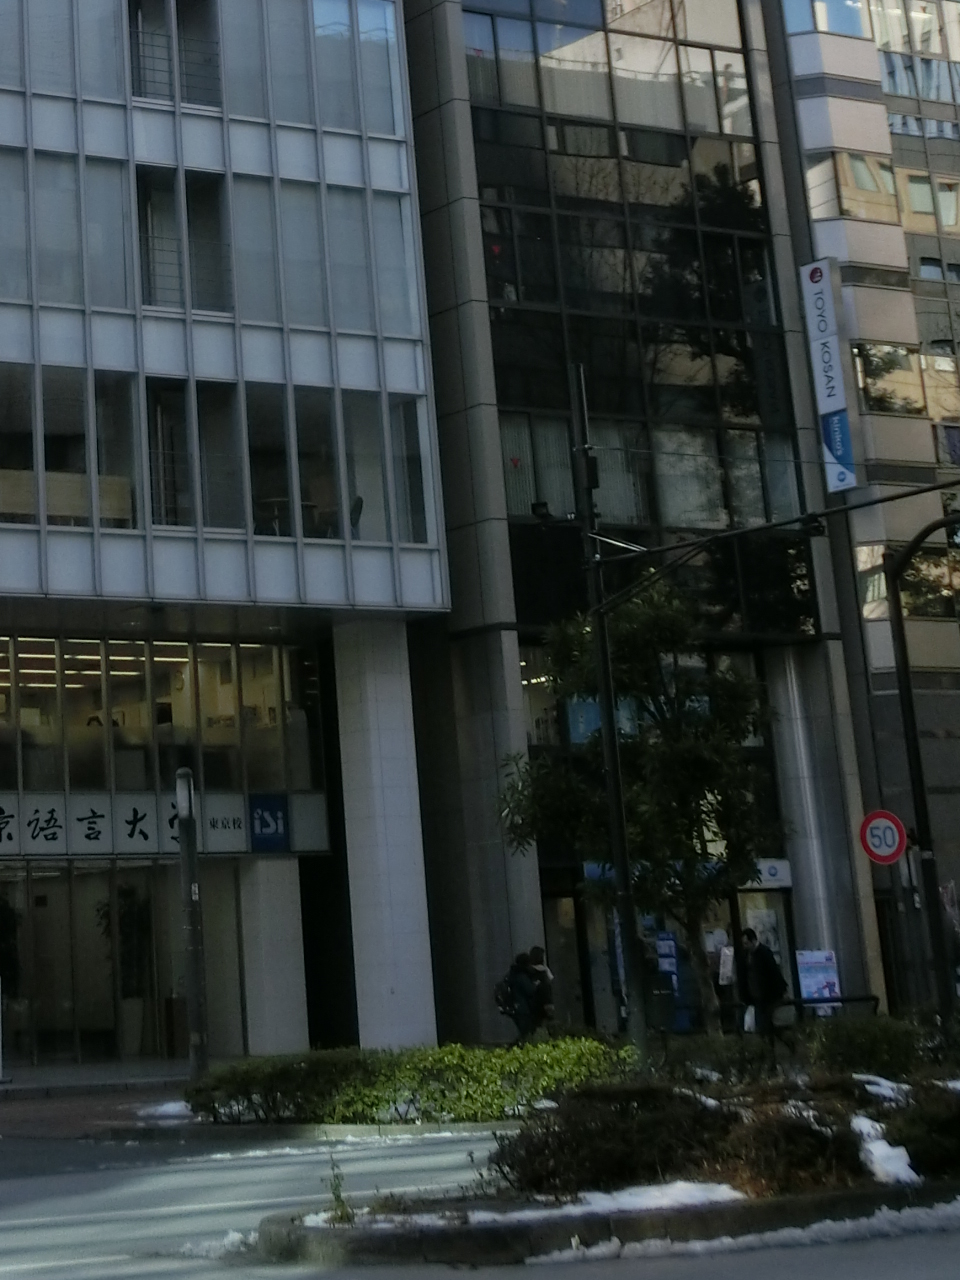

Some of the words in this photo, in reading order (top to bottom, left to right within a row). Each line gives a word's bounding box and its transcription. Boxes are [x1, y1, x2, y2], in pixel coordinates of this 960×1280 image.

[814, 288, 828, 333] TOYO
[820, 340, 837, 398] KOSAN
[869, 826, 895, 849] 50
